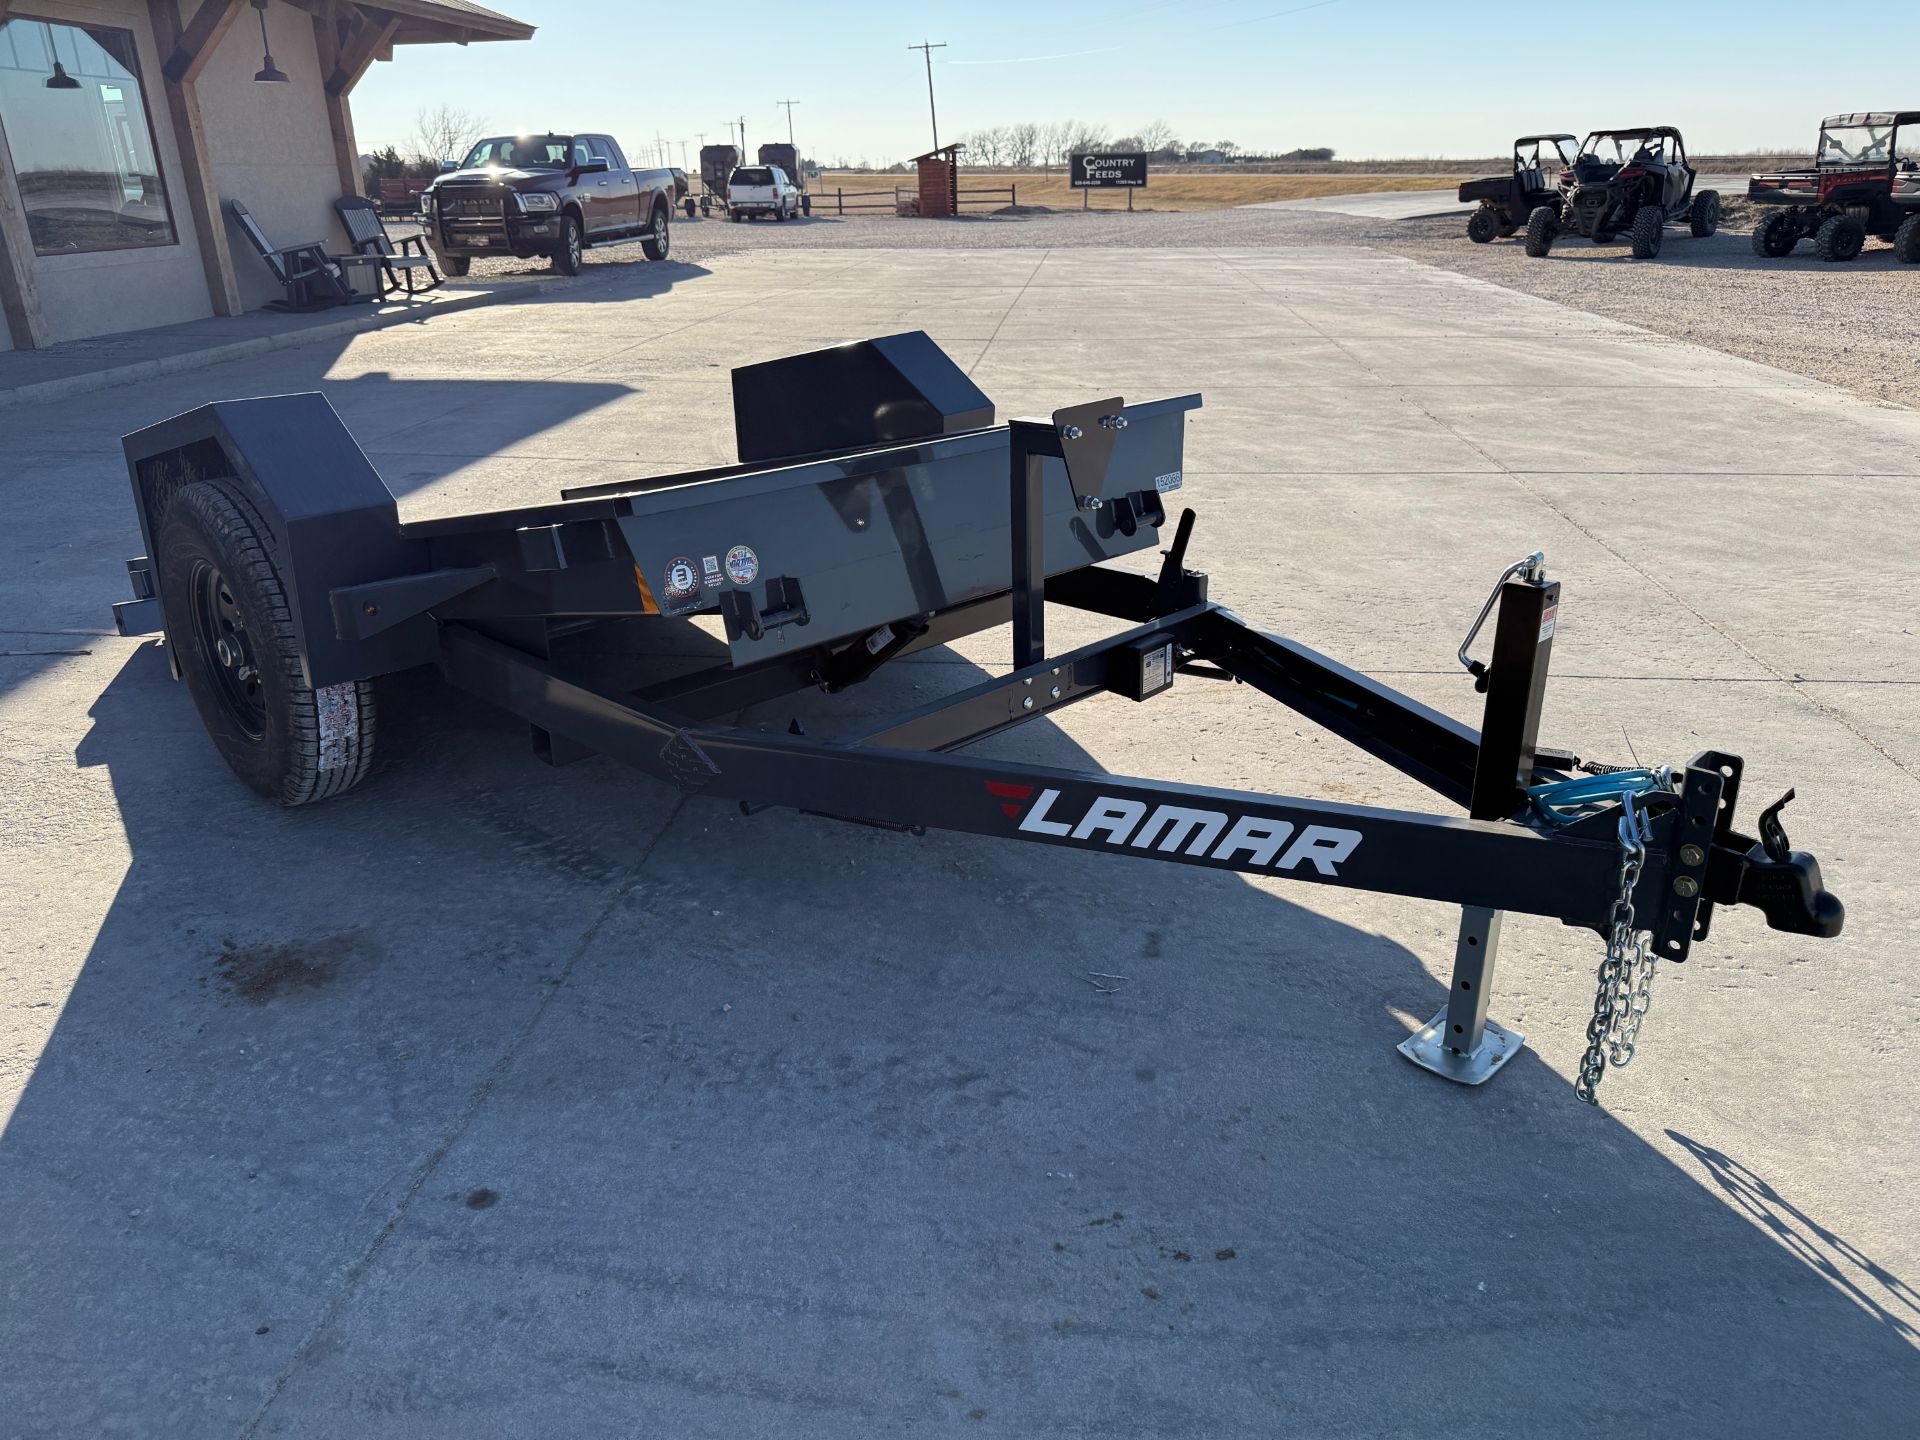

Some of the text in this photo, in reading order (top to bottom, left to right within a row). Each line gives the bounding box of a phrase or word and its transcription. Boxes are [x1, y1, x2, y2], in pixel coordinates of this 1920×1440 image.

[1083, 156, 1136, 169] COUNTRY
[1086, 166, 1122, 179] FEEDS
[1018, 788, 1364, 877] LAMAR
